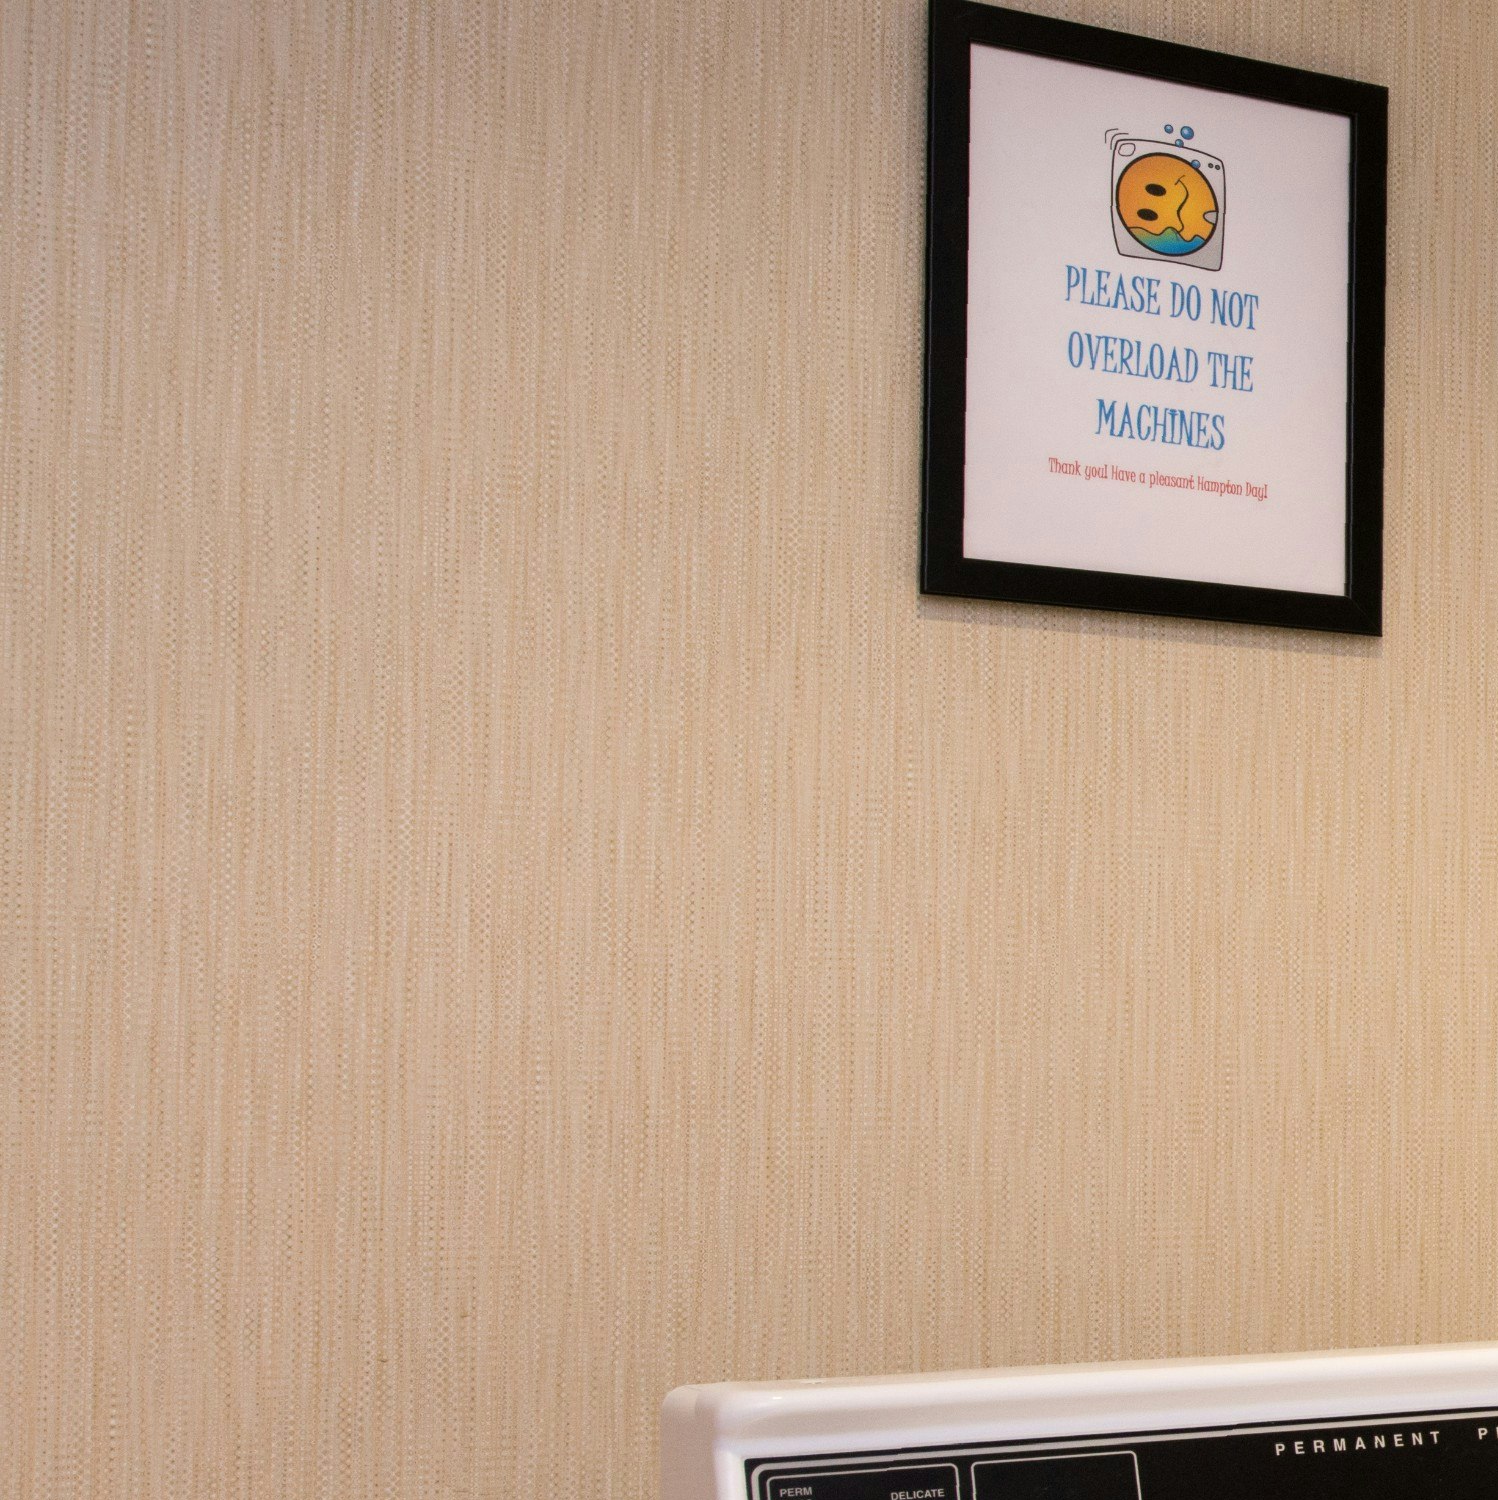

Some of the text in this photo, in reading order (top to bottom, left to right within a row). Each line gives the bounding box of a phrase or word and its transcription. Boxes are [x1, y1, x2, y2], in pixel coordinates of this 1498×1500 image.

[1065, 264, 1259, 330] PLEASE DO NOT
[1068, 331, 1254, 393] OVERLOAD THE
[1095, 398, 1225, 451] MACHINES
[1048, 457, 1081, 476] Thank
[1111, 465, 1137, 483] Have
[1138, 472, 1146, 484] a
[1149, 470, 1195, 490] pleasant
[1197, 475, 1243, 497] Hampton
[1275, 1430, 1440, 1456] PERMANENT
[779, 1486, 813, 1498] PERM
[890, 1488, 945, 1500] DELICATE
